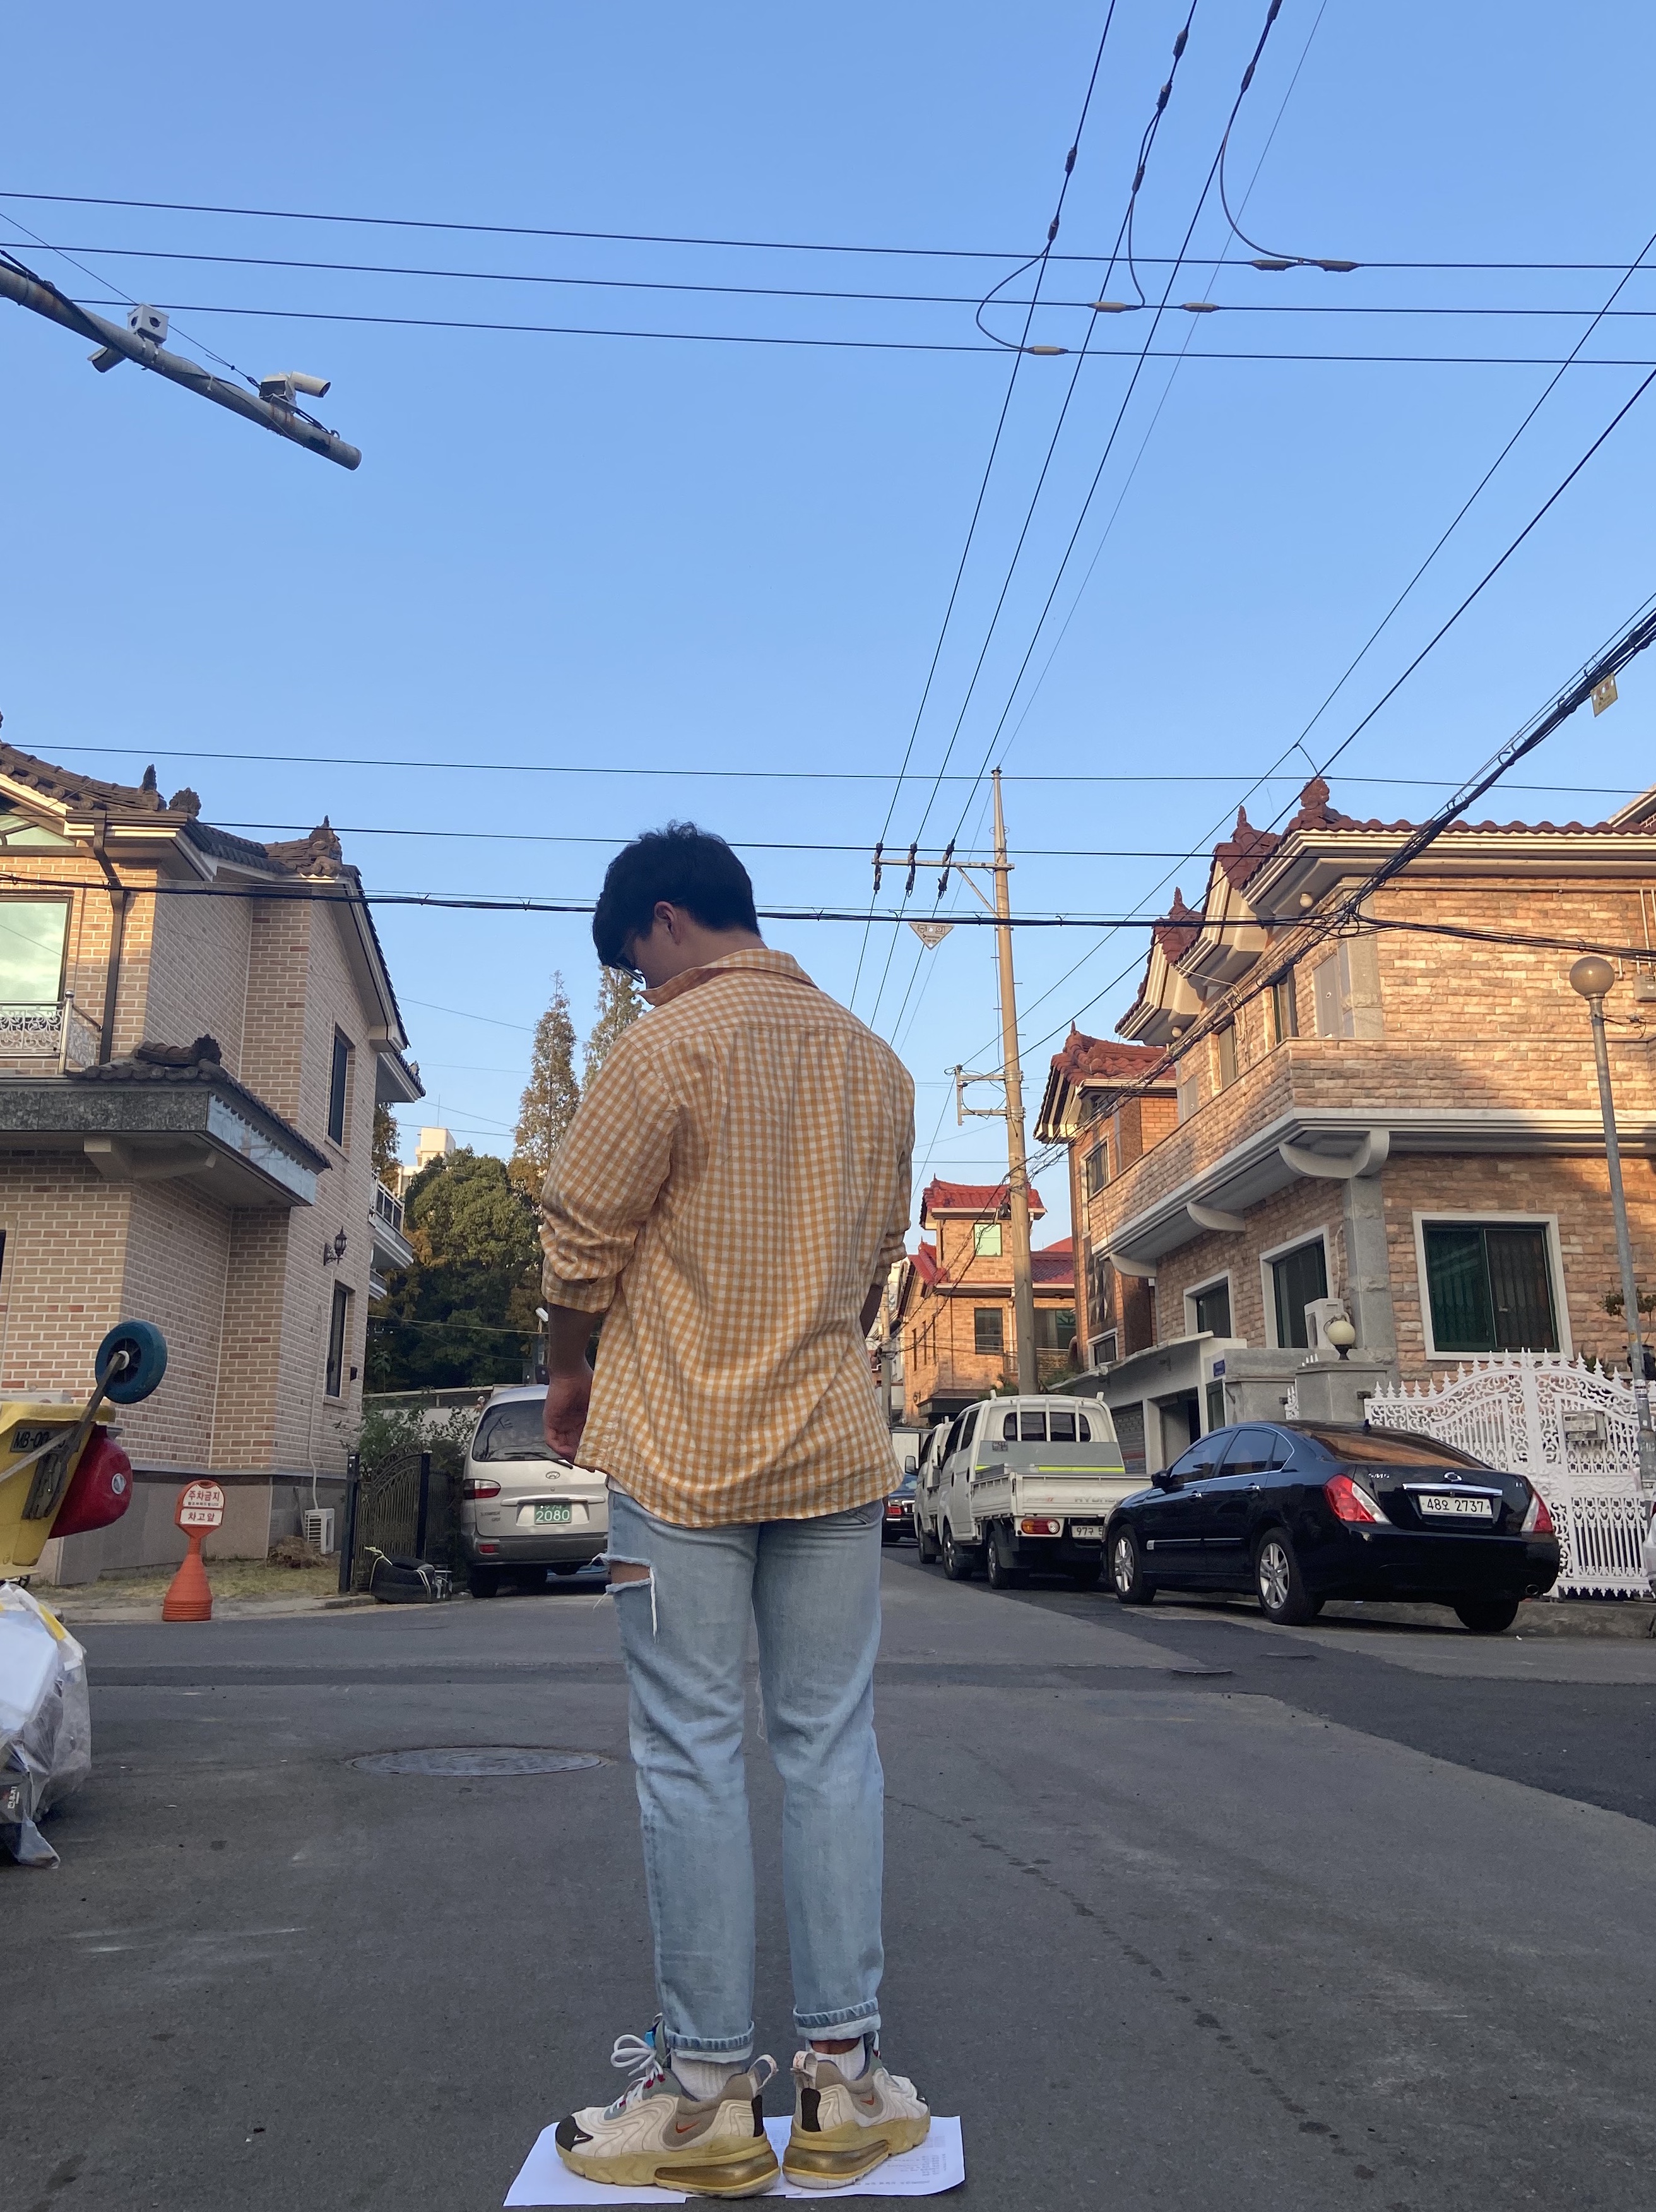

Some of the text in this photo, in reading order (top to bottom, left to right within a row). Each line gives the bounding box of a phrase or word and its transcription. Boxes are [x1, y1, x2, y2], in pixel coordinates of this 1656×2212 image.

[188, 1490, 220, 1502] 주차금지
[1428, 1498, 1484, 1513] 48오 2737
[188, 1512, 215, 1522] 차고앞
[536, 1509, 570, 1521] 2080
[1076, 1526, 1094, 1536] 97구
